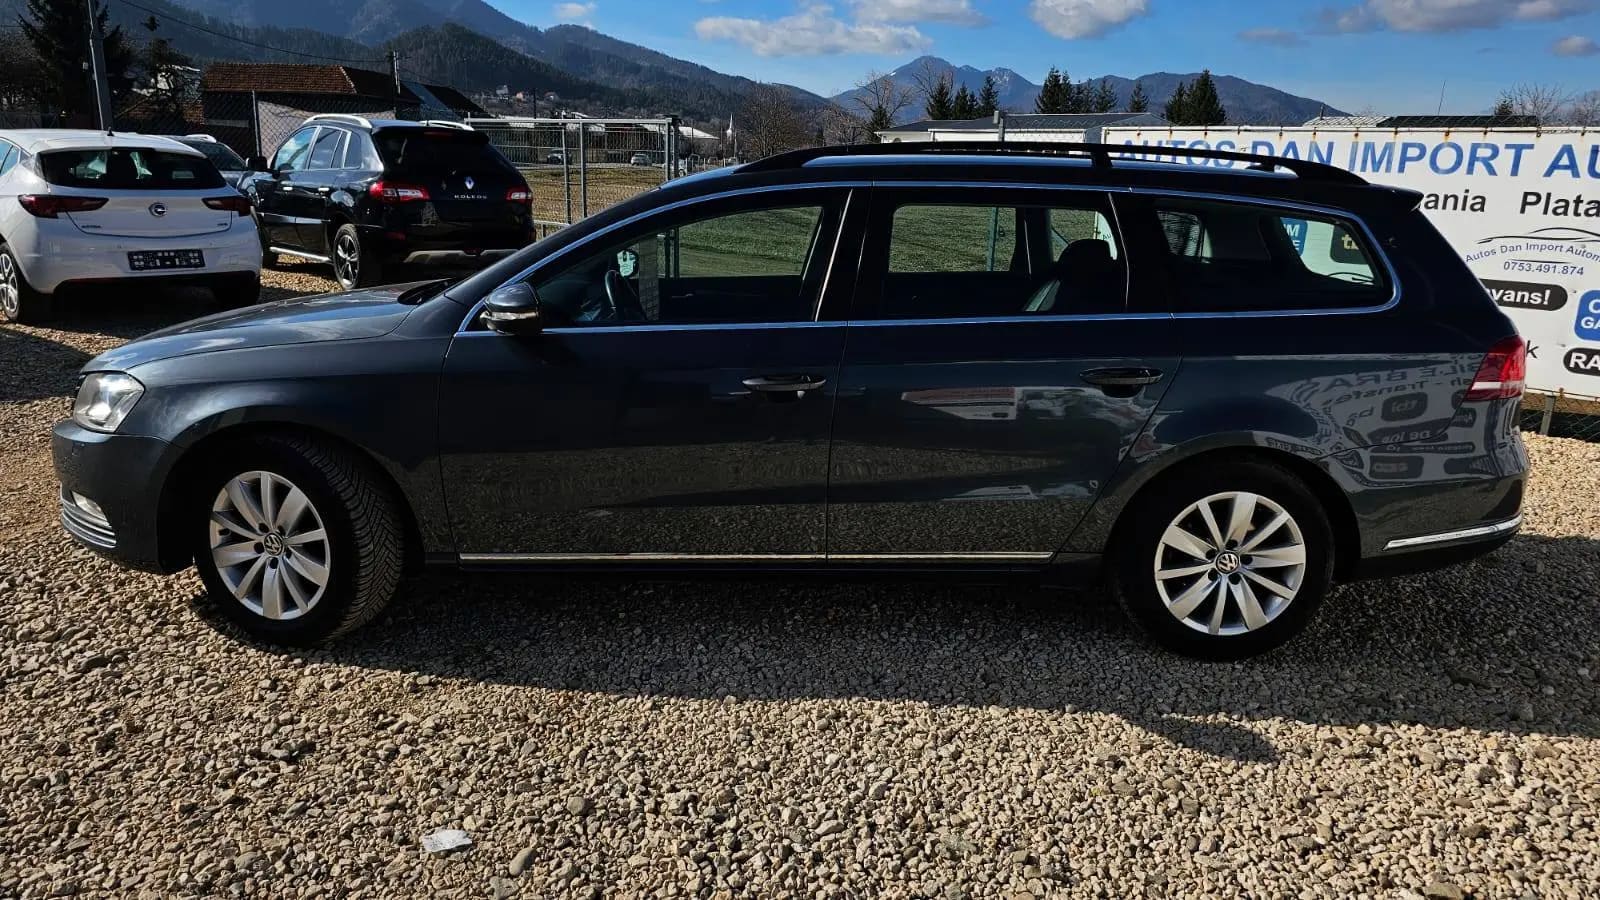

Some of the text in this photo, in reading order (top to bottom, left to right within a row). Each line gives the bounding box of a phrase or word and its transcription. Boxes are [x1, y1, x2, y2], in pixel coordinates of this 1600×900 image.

[1349, 141, 1535, 177] IMPORT
[1419, 188, 1600, 218] ania Plata
[1465, 247, 1497, 263] Autos
[1500, 243, 1522, 254] Dan
[1526, 242, 1564, 253] Import
[1503, 261, 1584, 276] 0753.491.874
[1489, 288, 1552, 305] vans!
